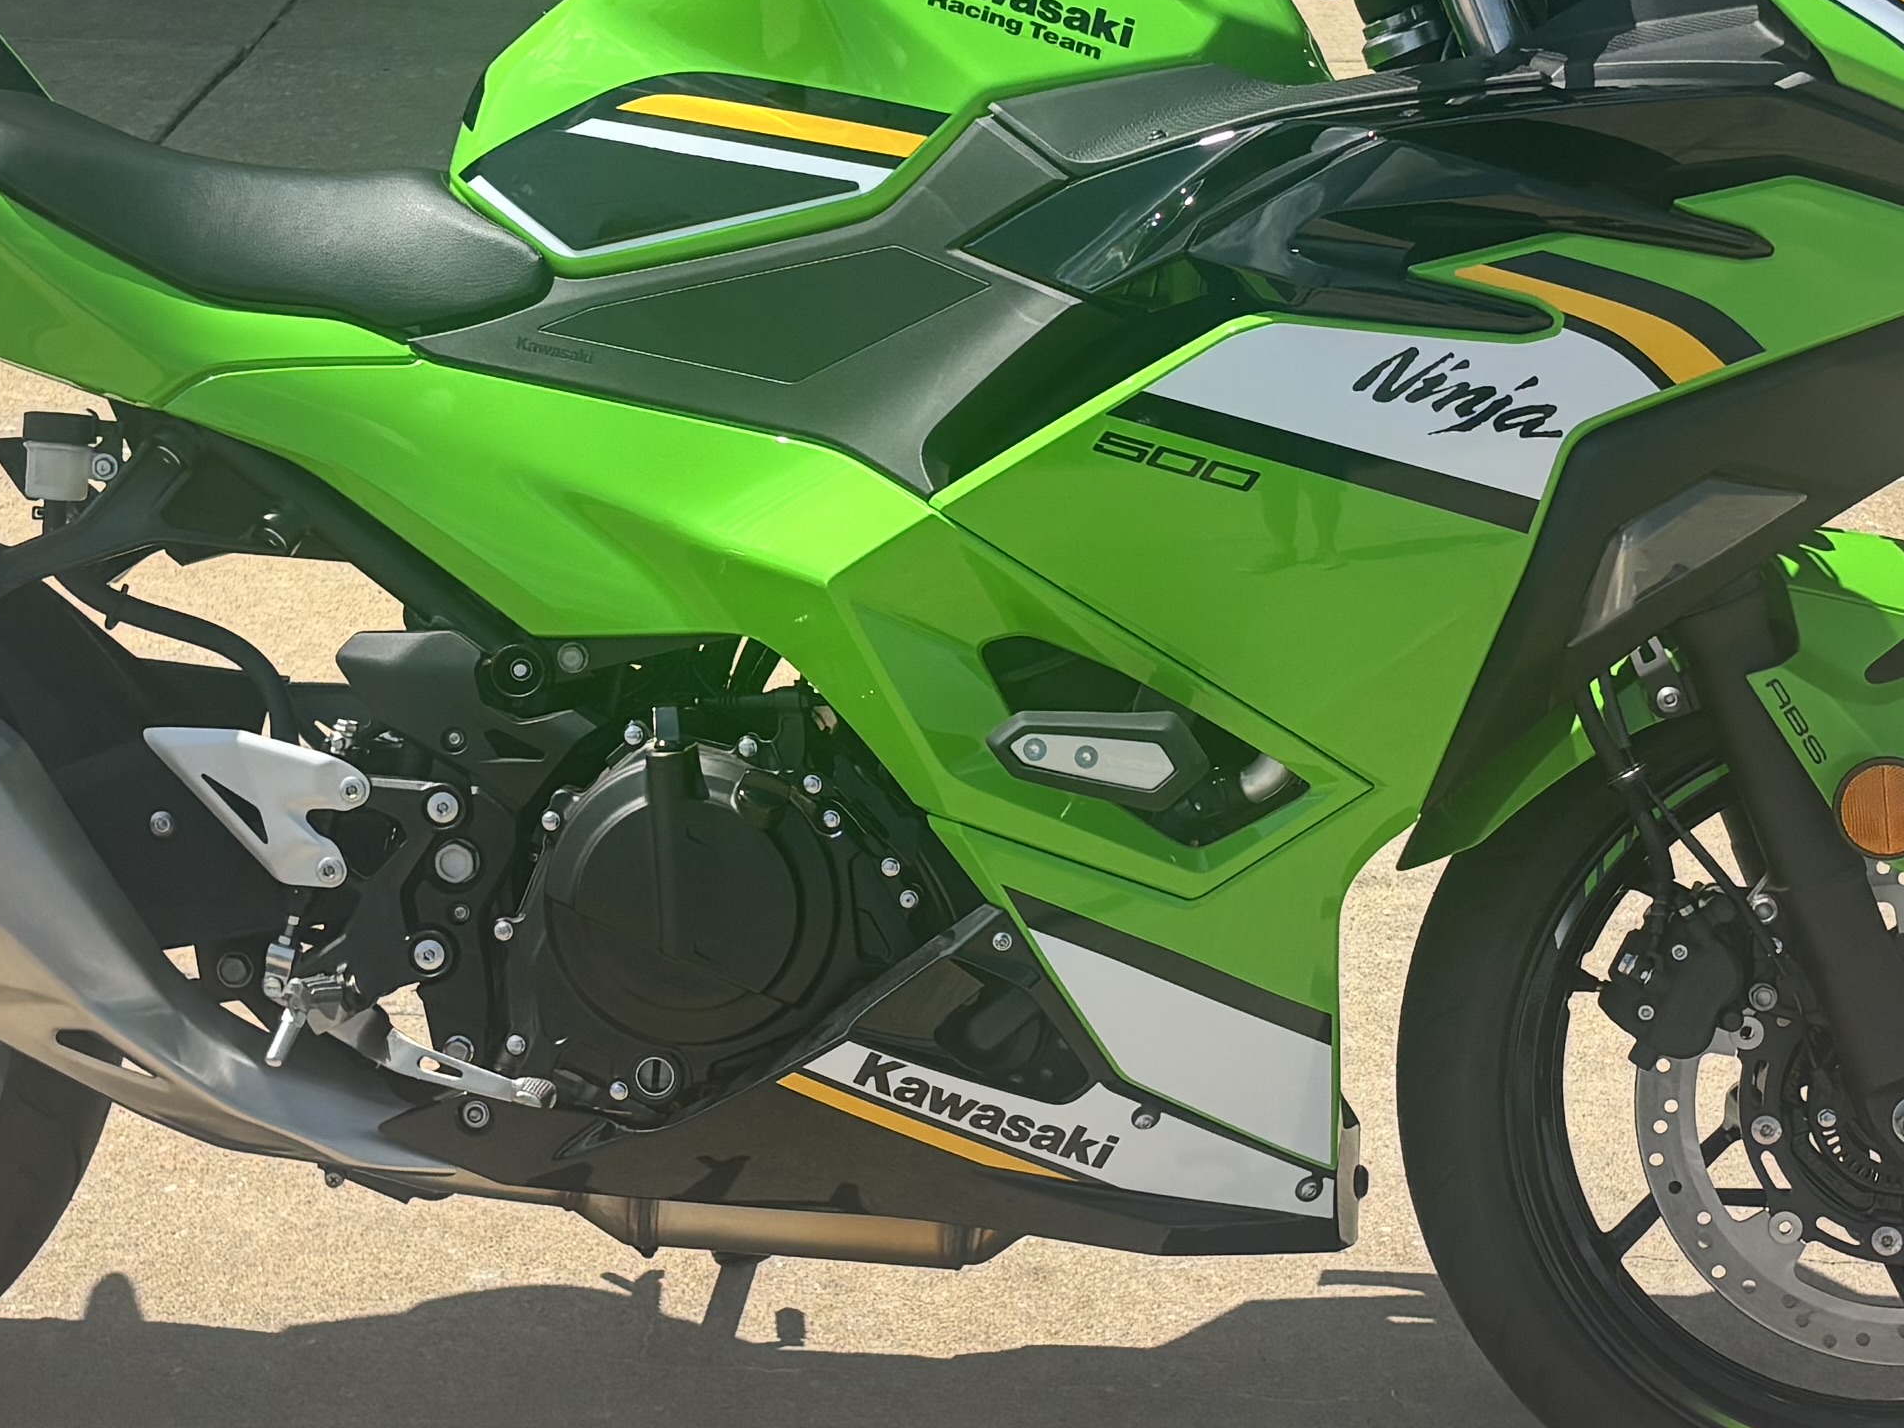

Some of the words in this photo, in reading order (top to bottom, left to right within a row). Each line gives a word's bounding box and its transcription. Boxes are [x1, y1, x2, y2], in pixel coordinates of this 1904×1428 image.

[1029, 20, 1102, 60] Team
[1352, 346, 1564, 440] Ninja
[1093, 430, 1262, 492] 500
[1765, 678, 1827, 765] ABS
[853, 1051, 1121, 1170] Kawasaki
